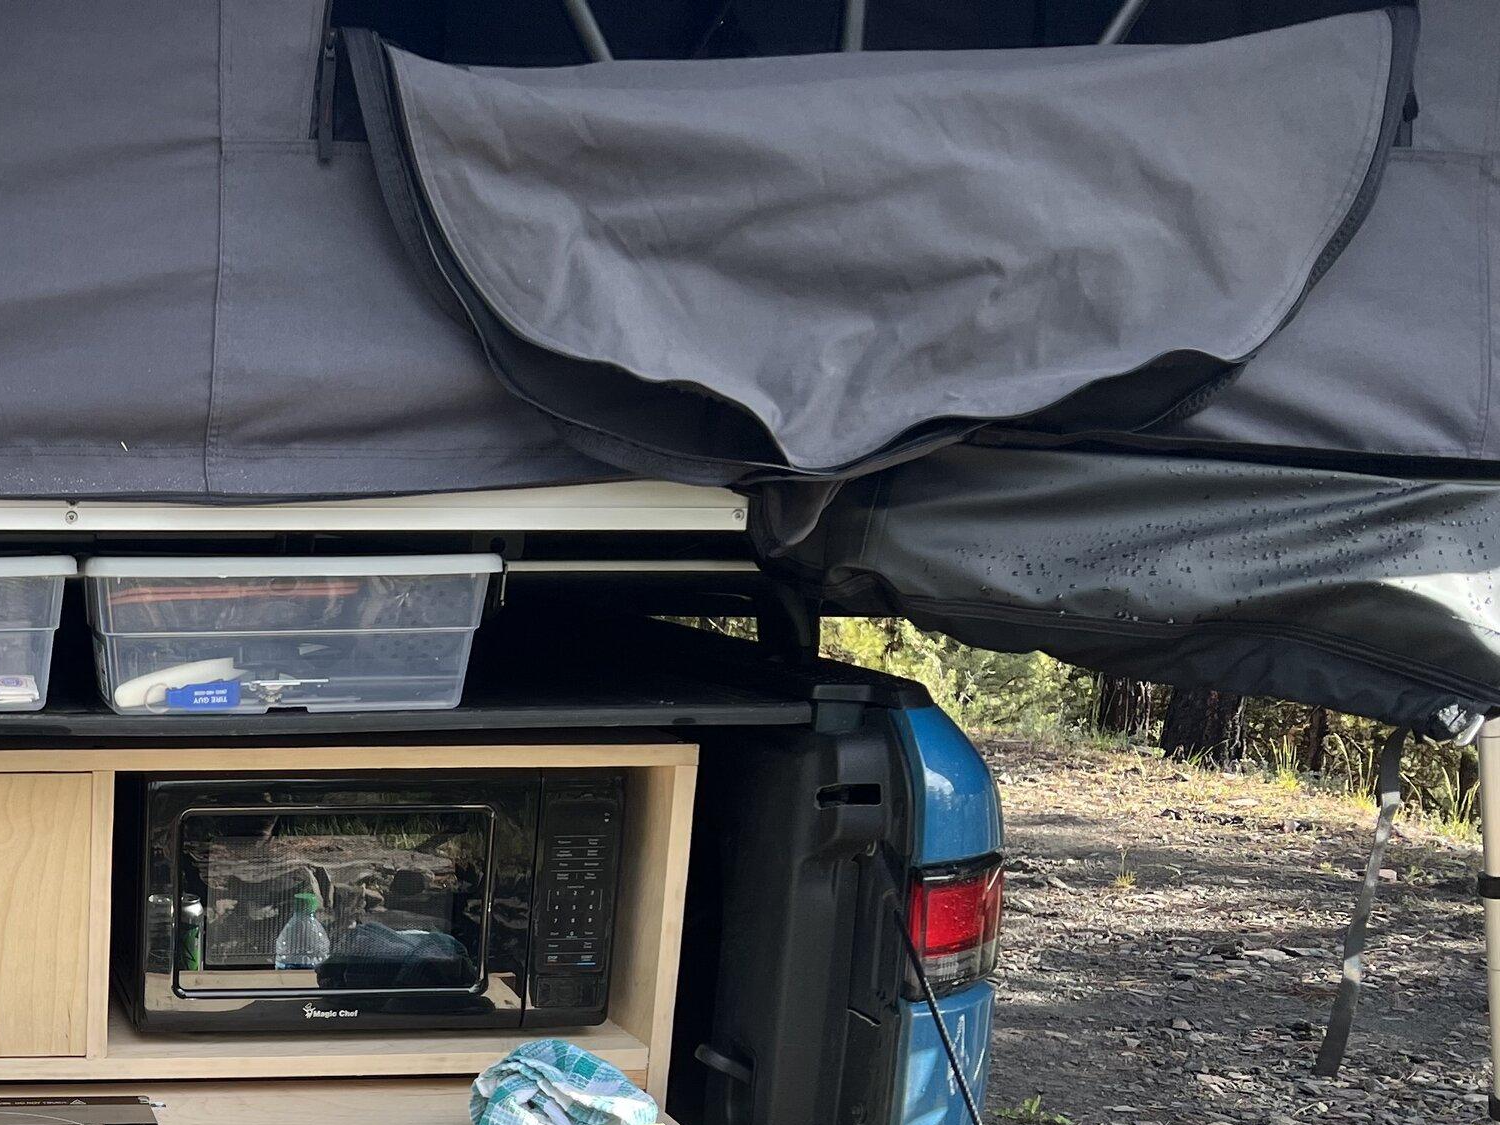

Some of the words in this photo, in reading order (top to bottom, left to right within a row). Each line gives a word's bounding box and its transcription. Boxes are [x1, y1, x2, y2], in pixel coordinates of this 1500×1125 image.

[193, 696, 210, 704] GUY
[313, 1010, 337, 1018] Magic
[338, 1009, 358, 1017] Chef
